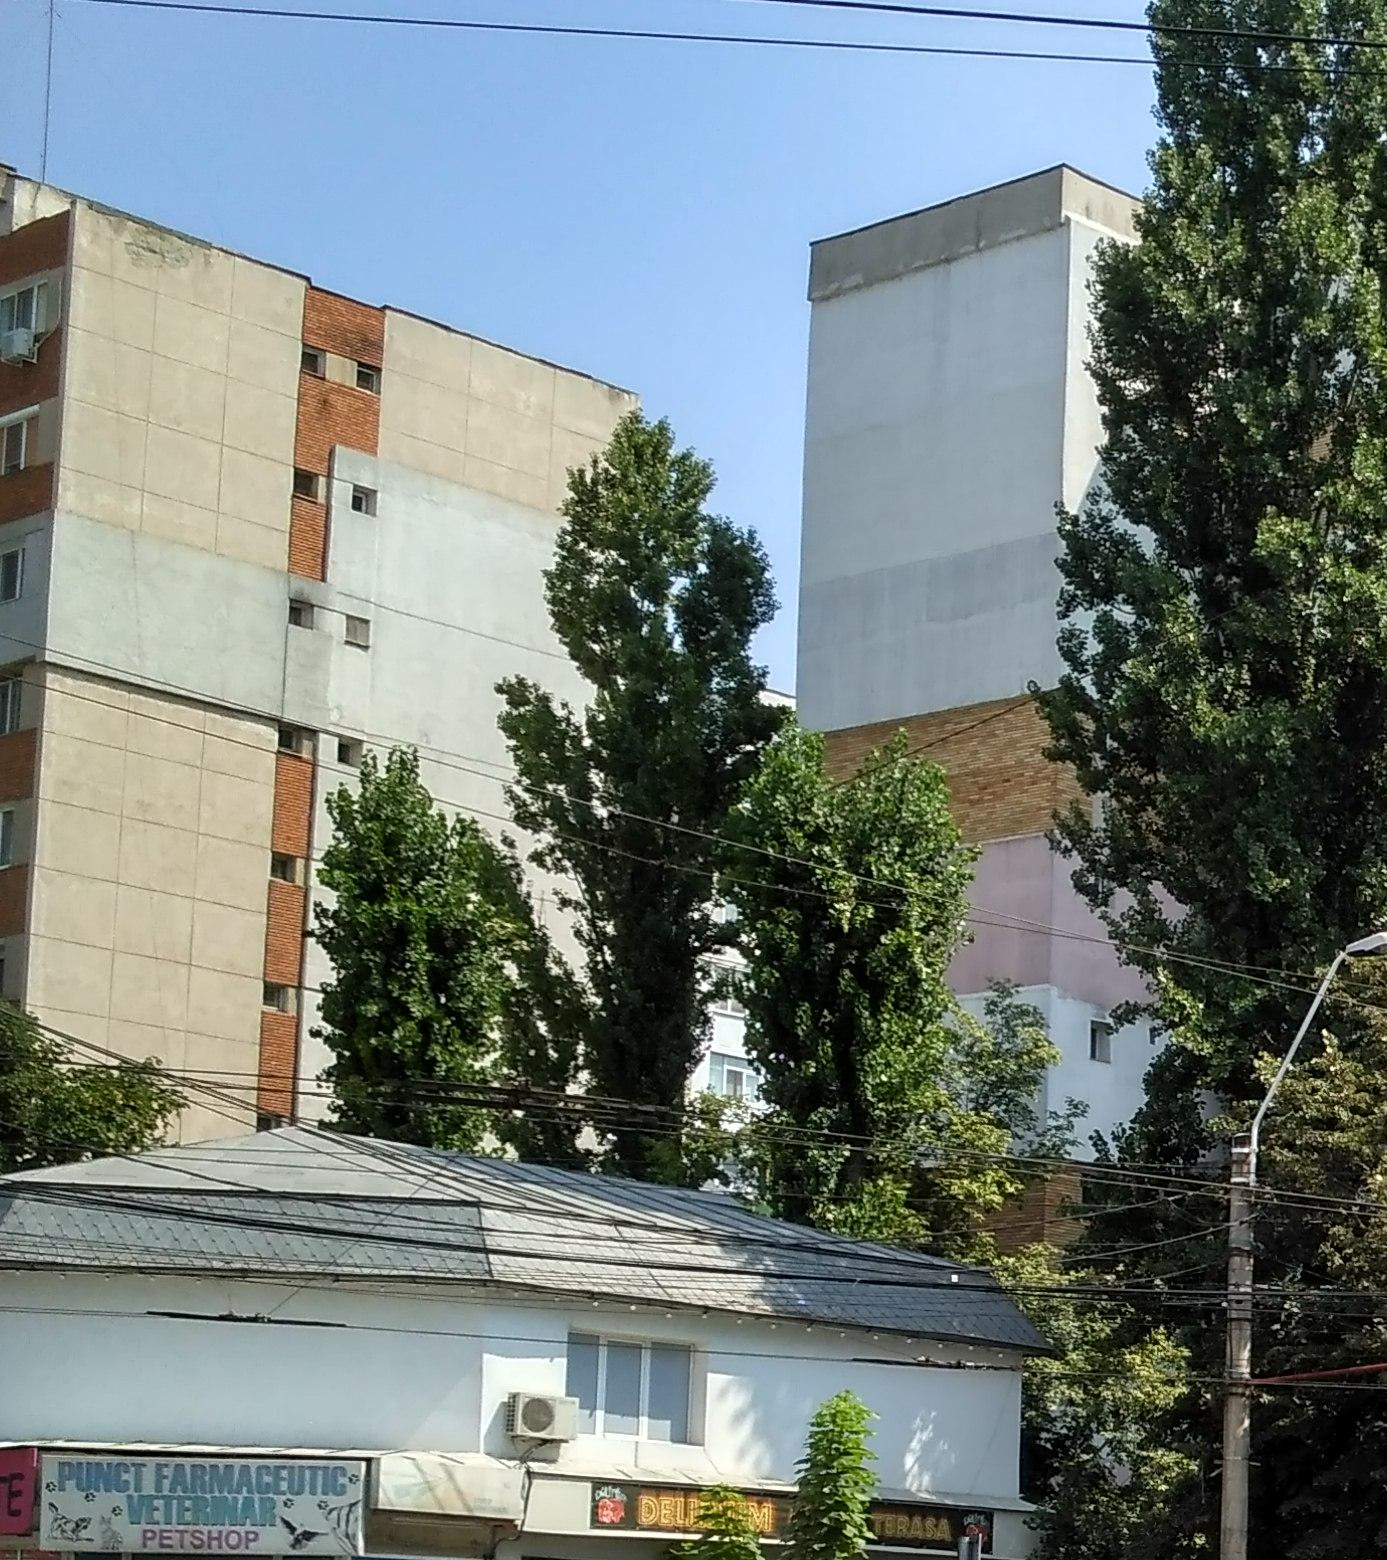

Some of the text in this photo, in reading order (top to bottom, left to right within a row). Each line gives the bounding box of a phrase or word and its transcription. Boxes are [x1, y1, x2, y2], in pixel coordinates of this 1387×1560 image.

[58, 1461, 348, 1497] PUNCT FARMACEUTIC
[126, 1494, 278, 1527] VETERINAR
[141, 1528, 261, 1550] PETSHOP
[871, 1512, 952, 1542] TERASA
